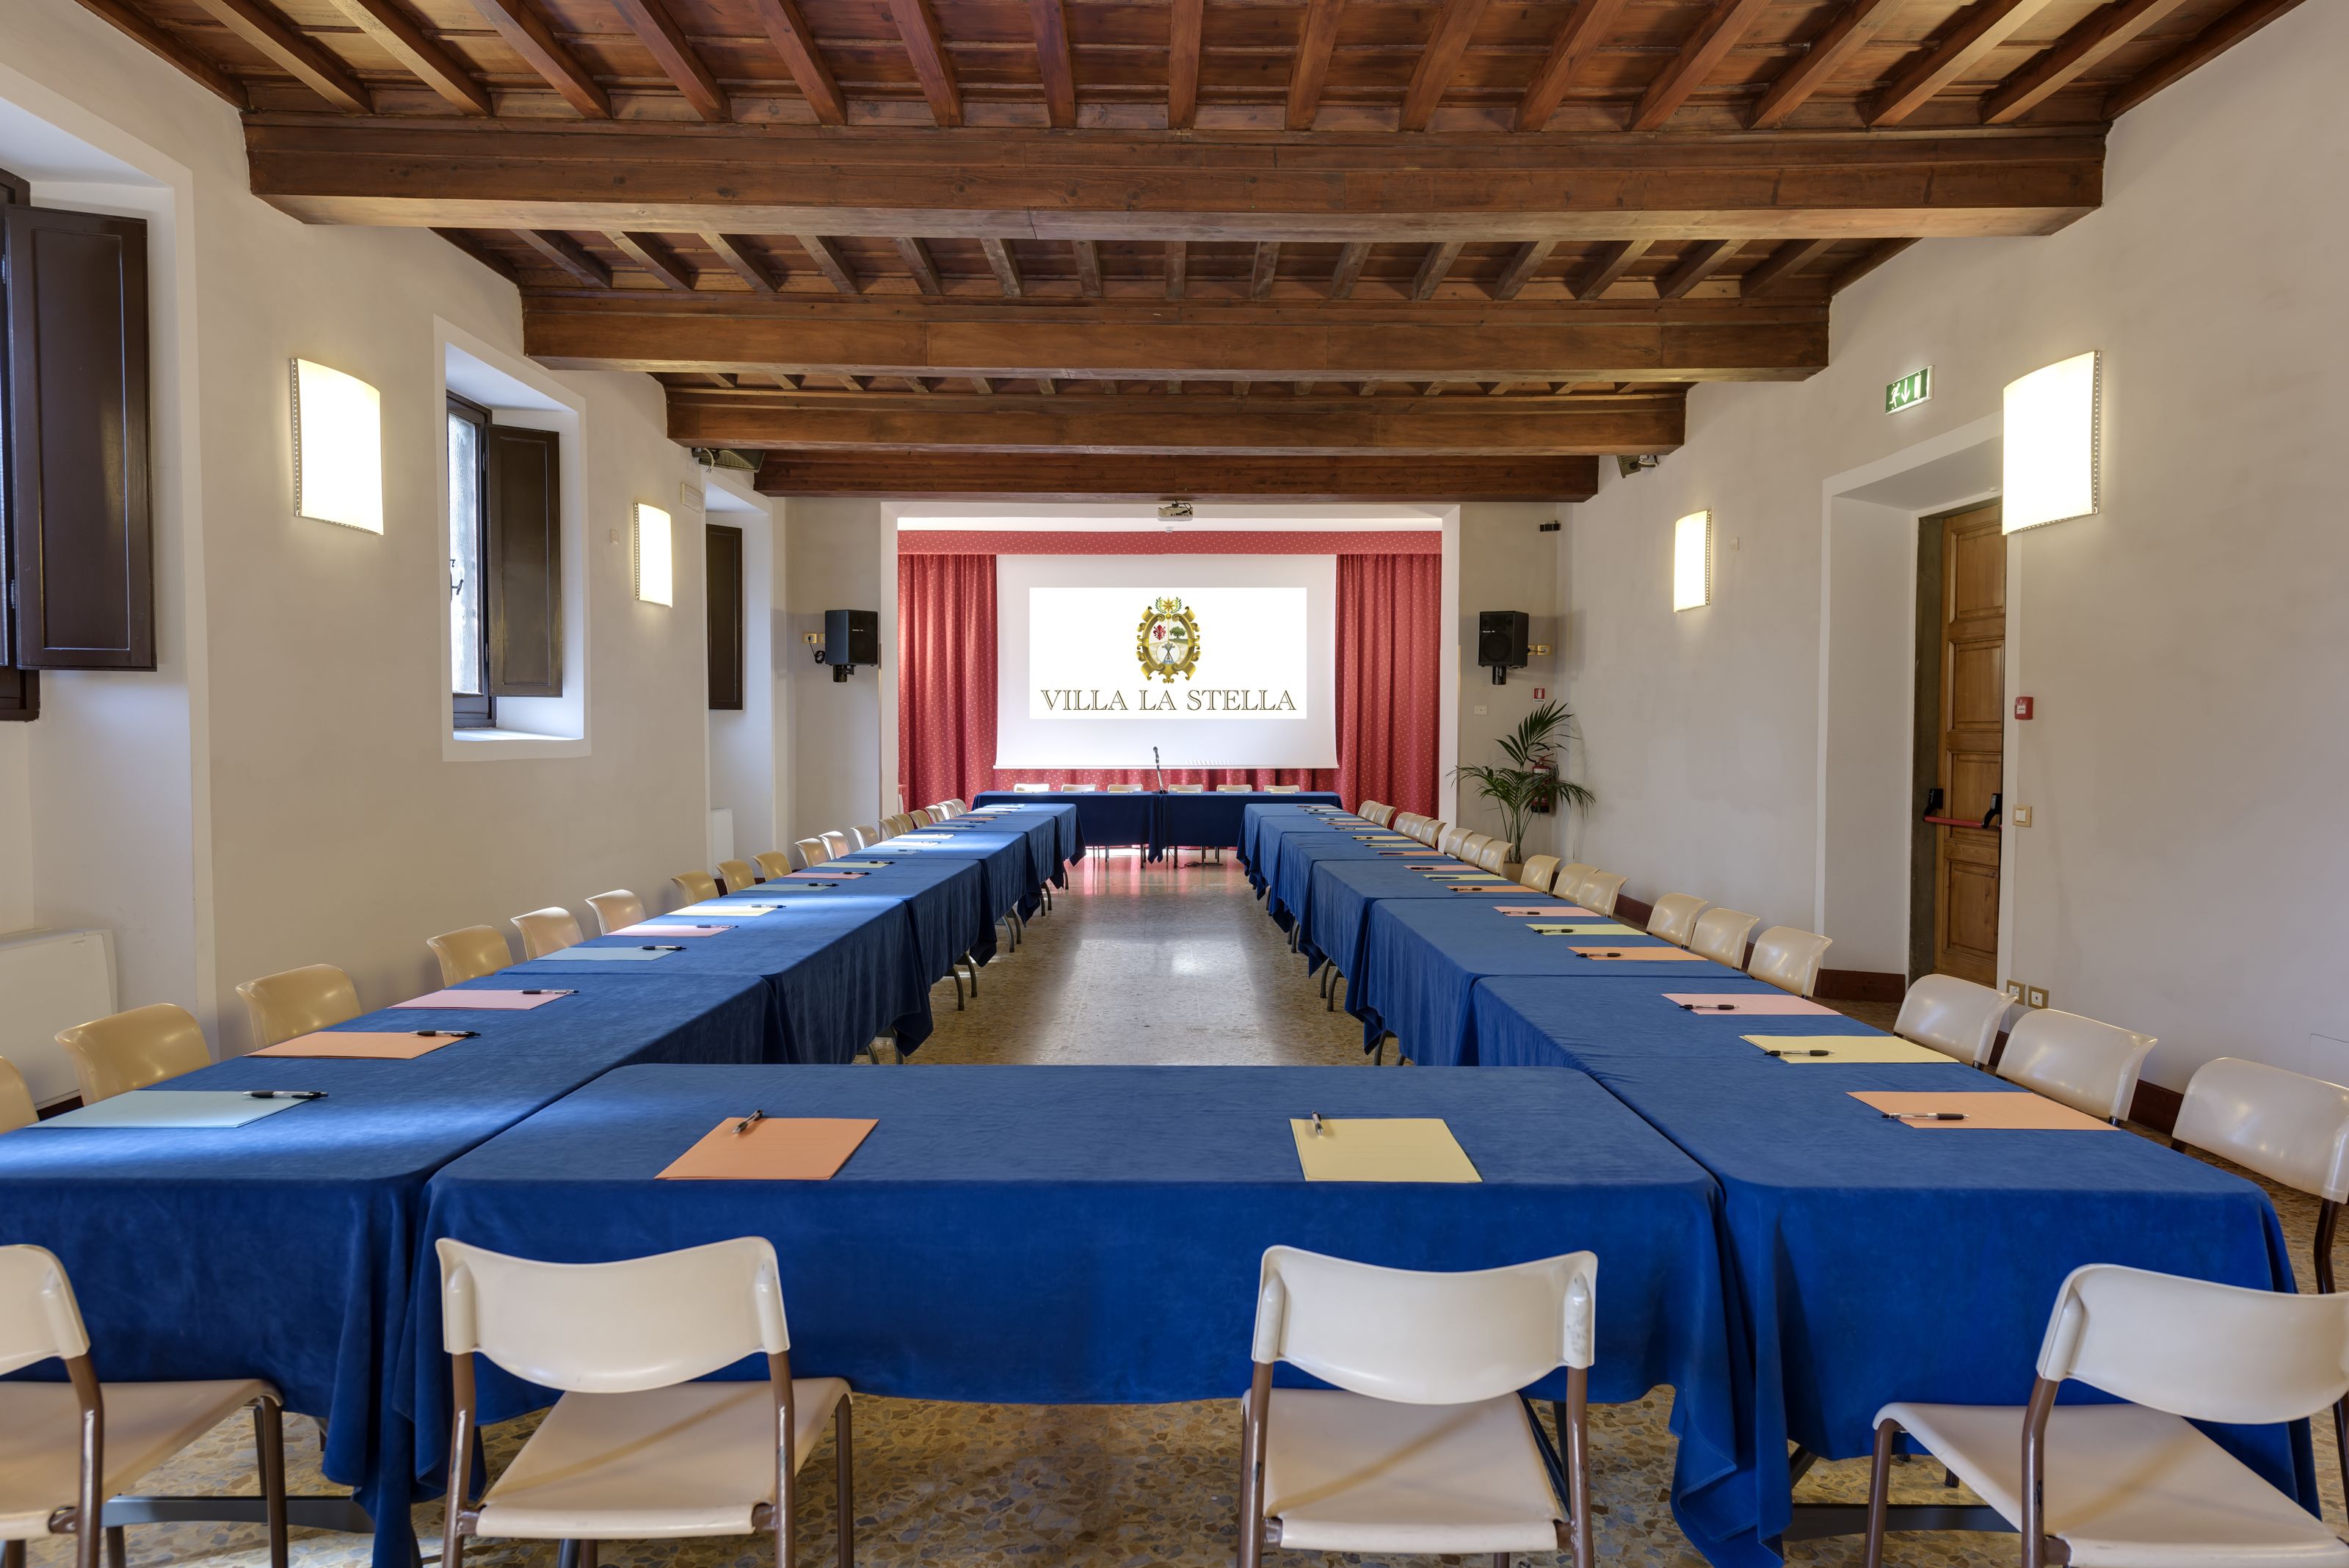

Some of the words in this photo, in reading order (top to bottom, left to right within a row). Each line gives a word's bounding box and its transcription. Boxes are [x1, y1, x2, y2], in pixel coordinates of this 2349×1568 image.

[1040, 689, 1129, 711] VILLA
[1139, 689, 1177, 711] LA
[1186, 689, 1297, 711] STELLA
